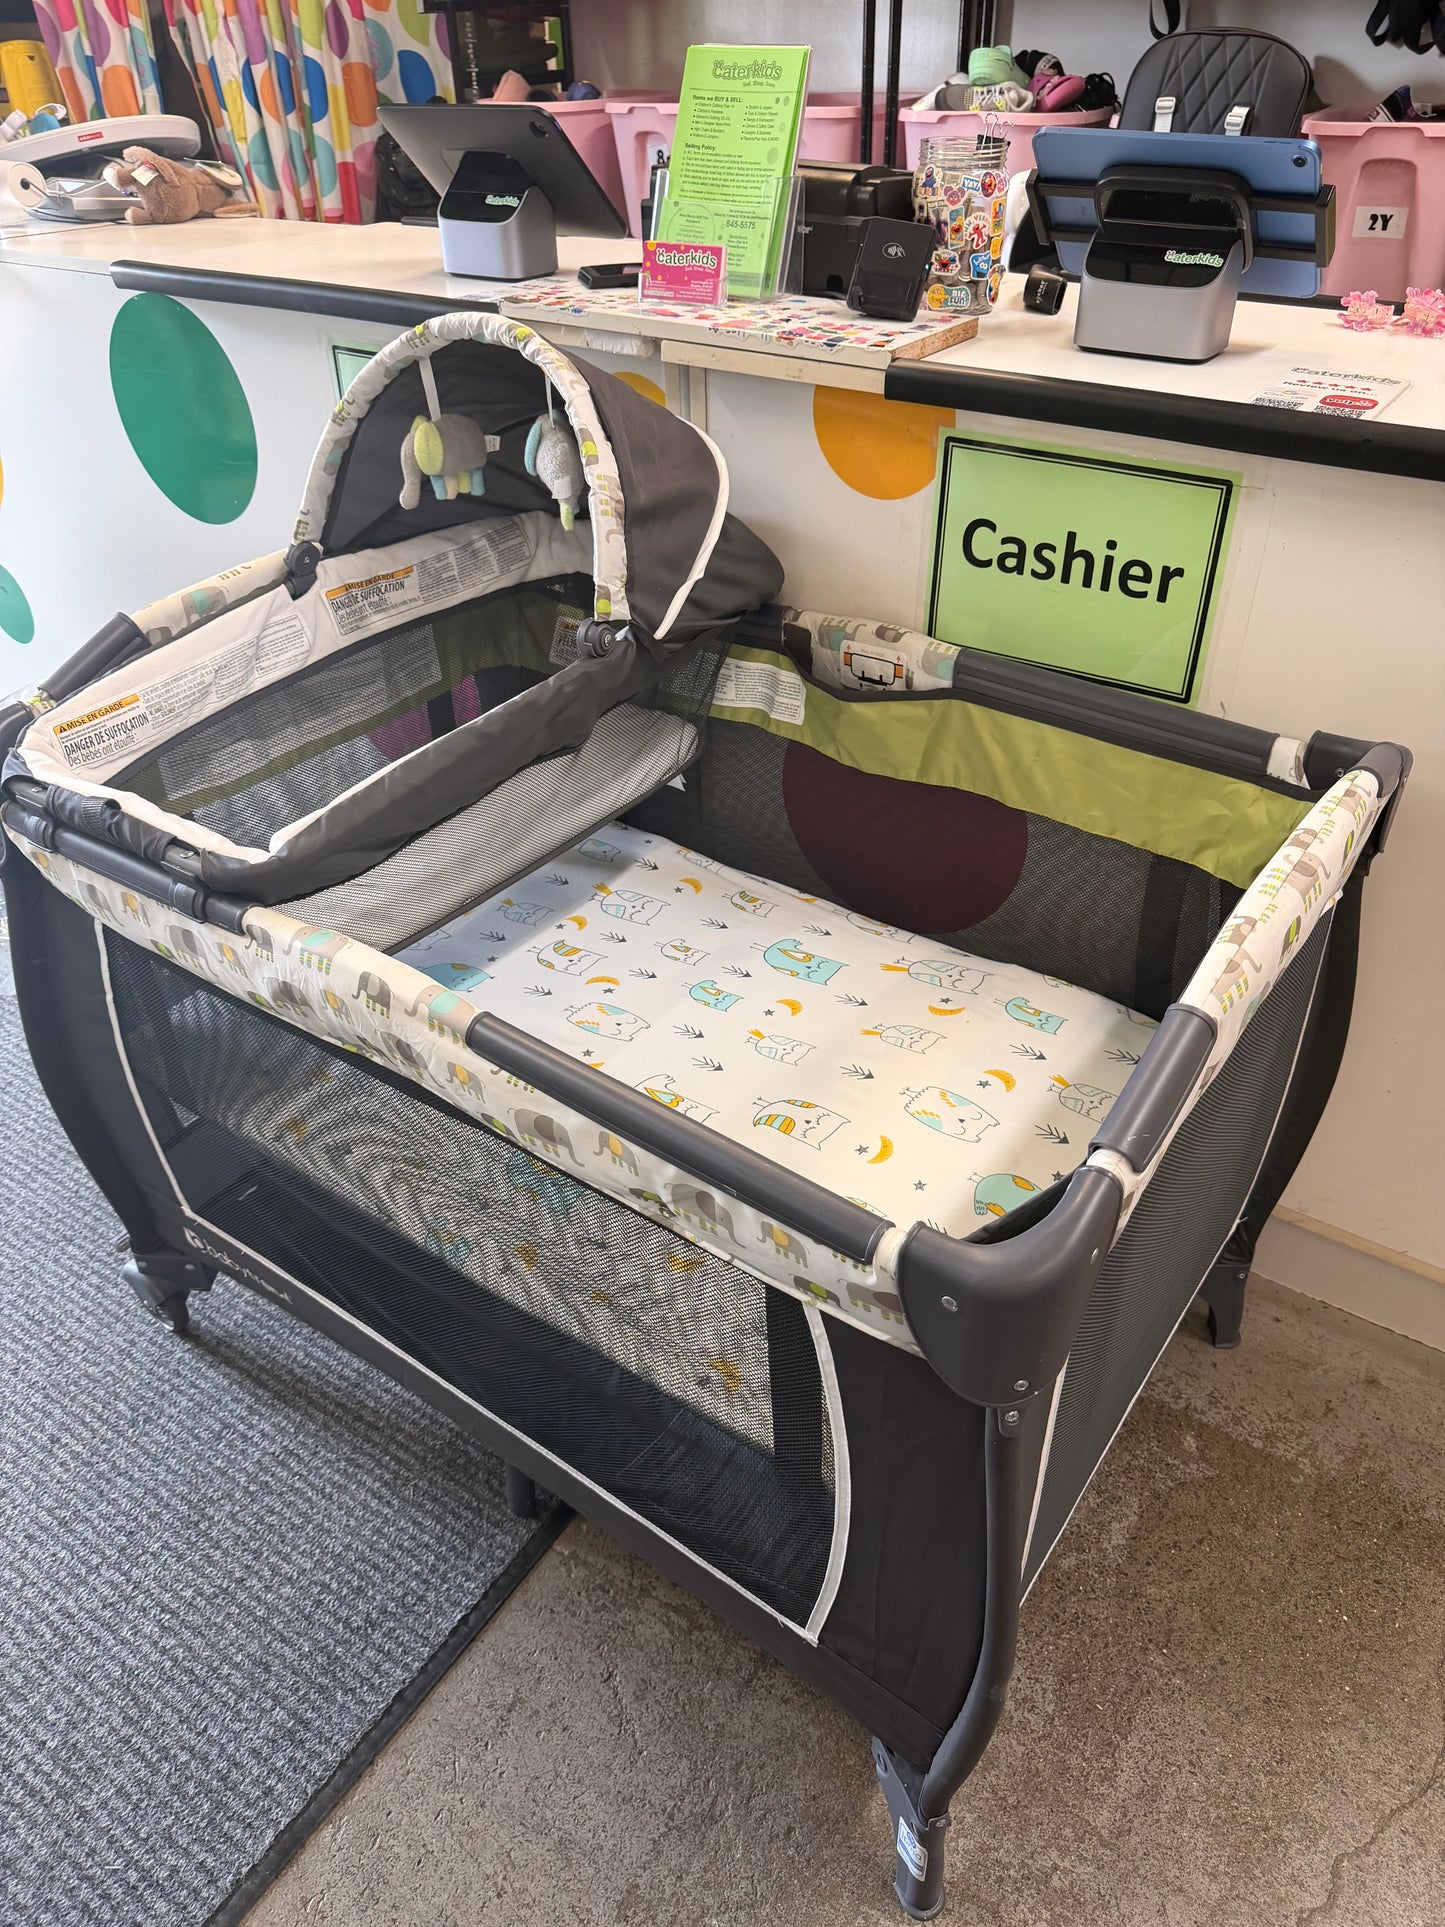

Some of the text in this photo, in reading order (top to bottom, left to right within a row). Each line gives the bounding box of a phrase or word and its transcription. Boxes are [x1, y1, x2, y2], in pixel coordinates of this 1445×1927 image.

[685, 142, 701, 150] Selling
[963, 178, 979, 189] YAY!
[726, 219, 756, 229] 845-5575
[1368, 213, 1394, 231] 2Y
[962, 518, 1185, 604] Cashier
[360, 580, 406, 604] SUFFOCATION
[66, 701, 126, 730] MISE EN GARDE
[64, 735, 95, 756] DANGER
[94, 731, 106, 745] DE
[104, 711, 150, 741] SUFFOCATION
[67, 755, 81, 767] Des
[102, 743, 114, 755] ont
